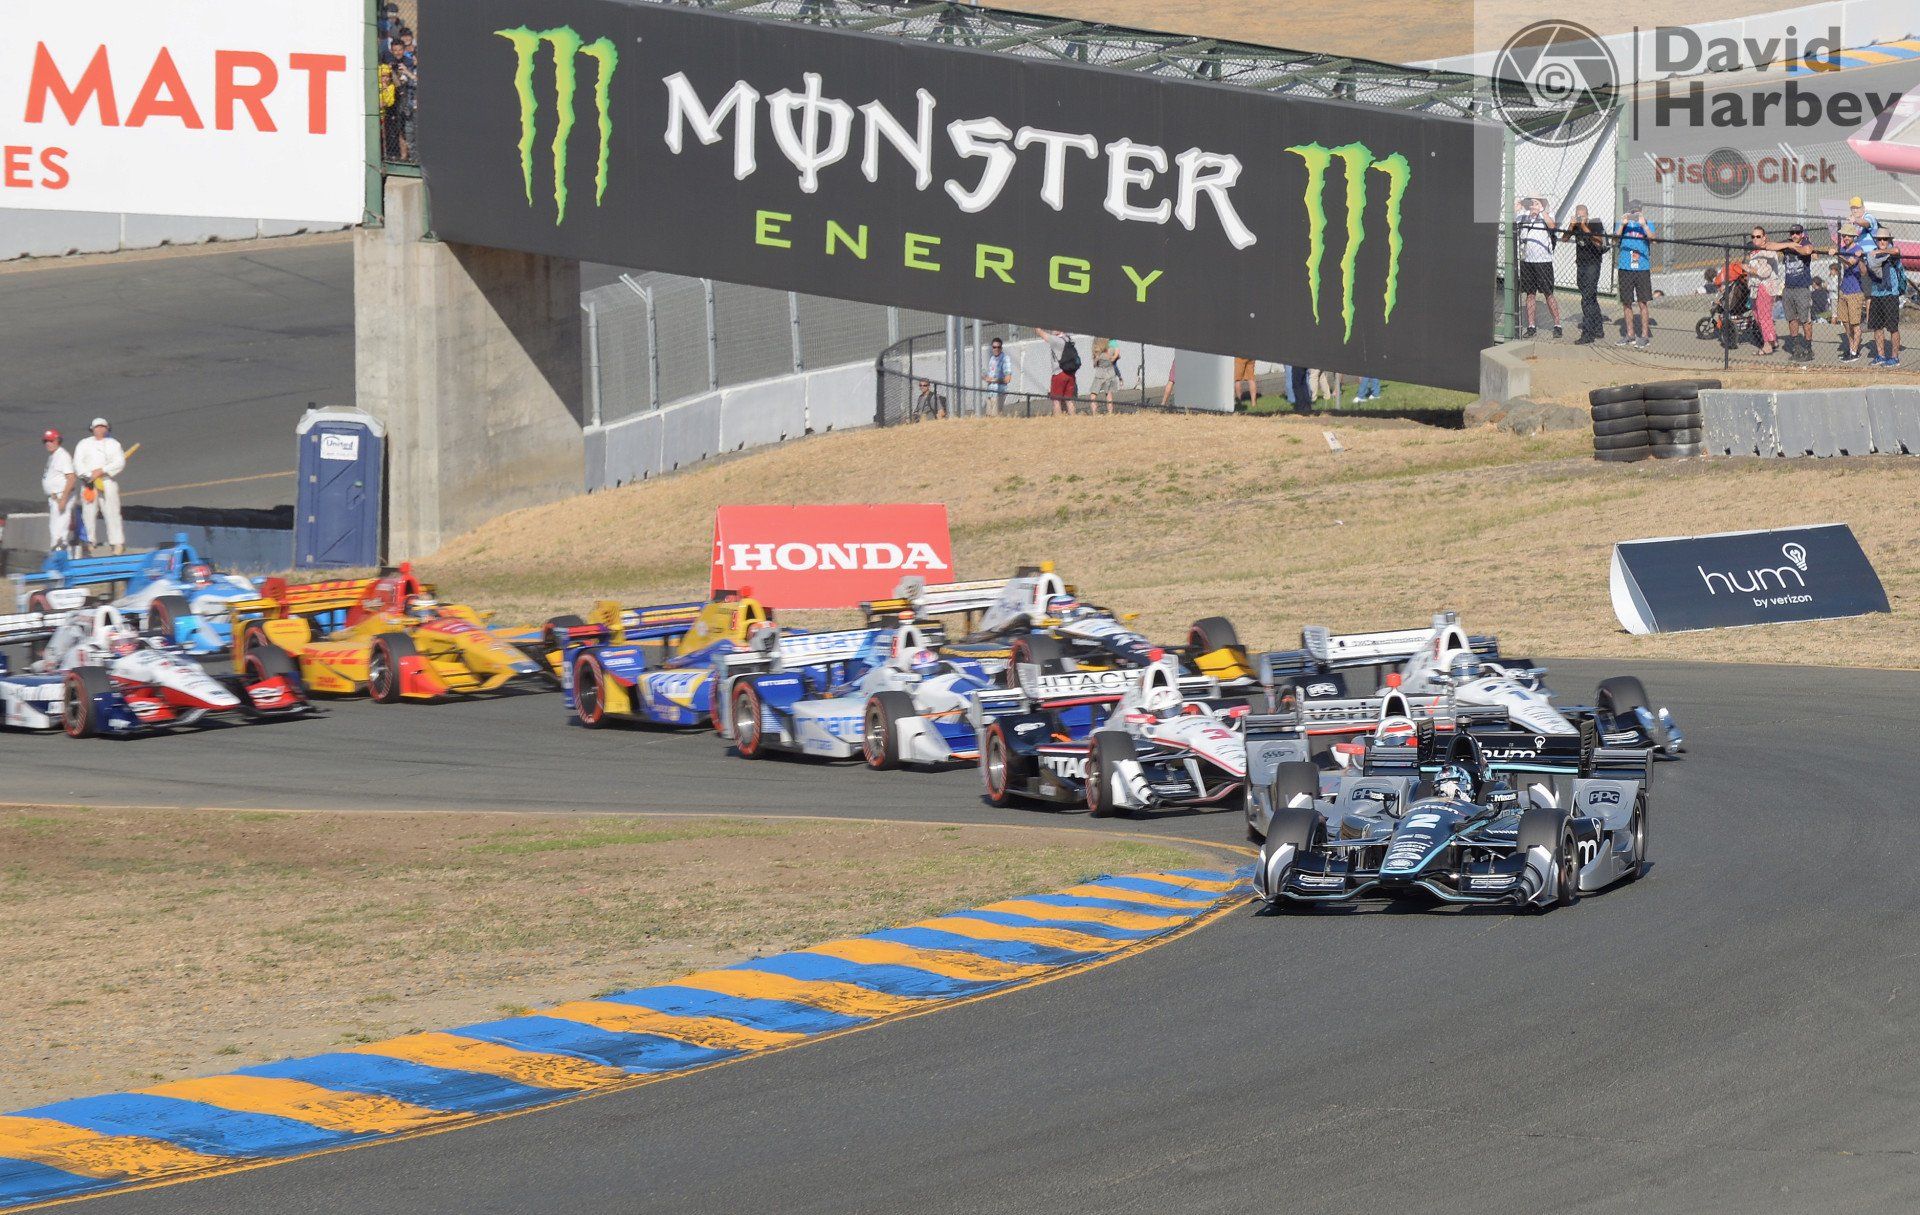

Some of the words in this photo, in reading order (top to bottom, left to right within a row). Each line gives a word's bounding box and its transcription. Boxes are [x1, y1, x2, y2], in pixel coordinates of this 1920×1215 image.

[24, 40, 347, 135] MART
[662, 71, 1257, 250] MONSTER
[754, 209, 1164, 303] ENERGY
[728, 542, 948, 571] HONDA
[1697, 565, 1805, 595] hum
[1753, 597, 1768, 608] by
[1770, 593, 1813, 605] verizon
[1590, 791, 1620, 803] PPG
[1406, 813, 1442, 829] 2
